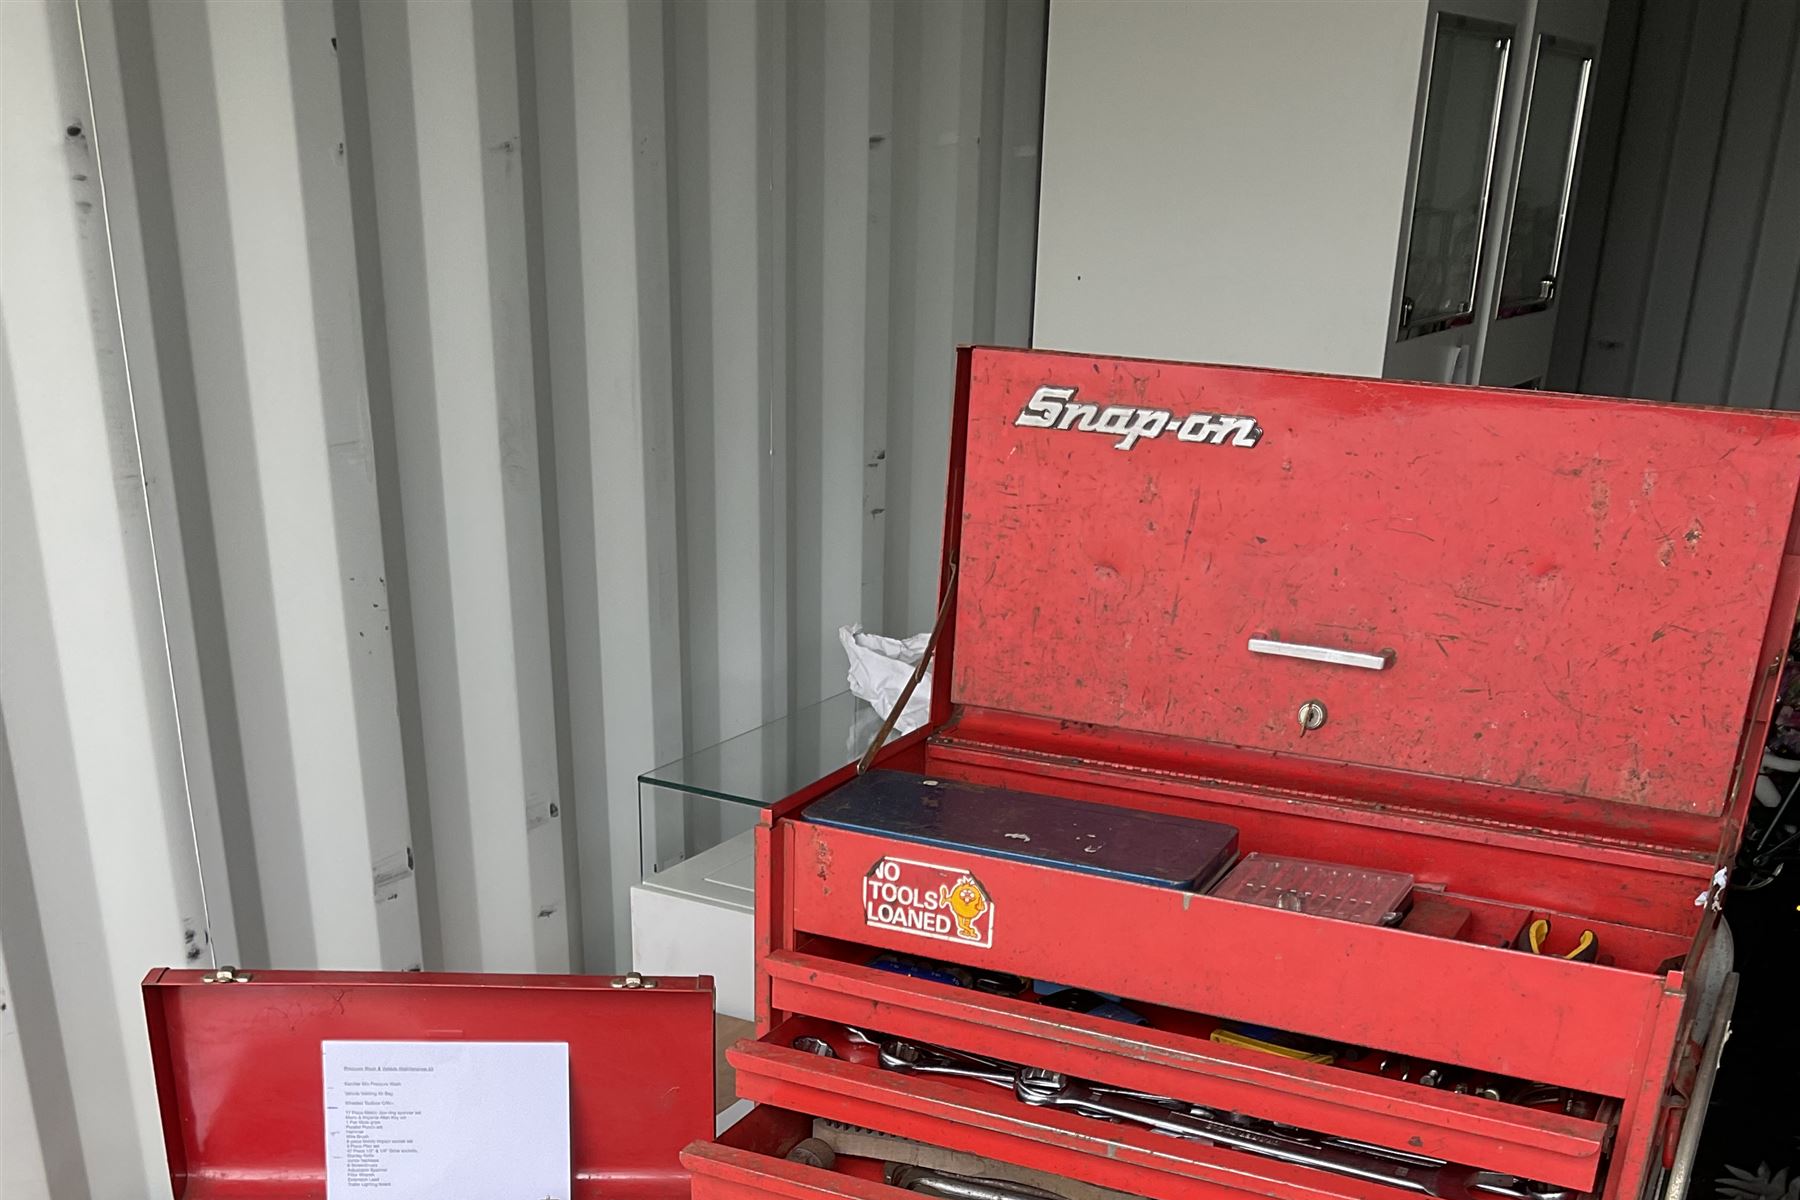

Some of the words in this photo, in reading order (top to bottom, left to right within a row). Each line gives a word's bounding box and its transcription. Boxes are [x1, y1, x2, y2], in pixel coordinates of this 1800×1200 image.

[1015, 384, 1262, 450] Snap-on
[868, 880, 938, 911] TOOLS
[867, 901, 951, 933] LOANED
